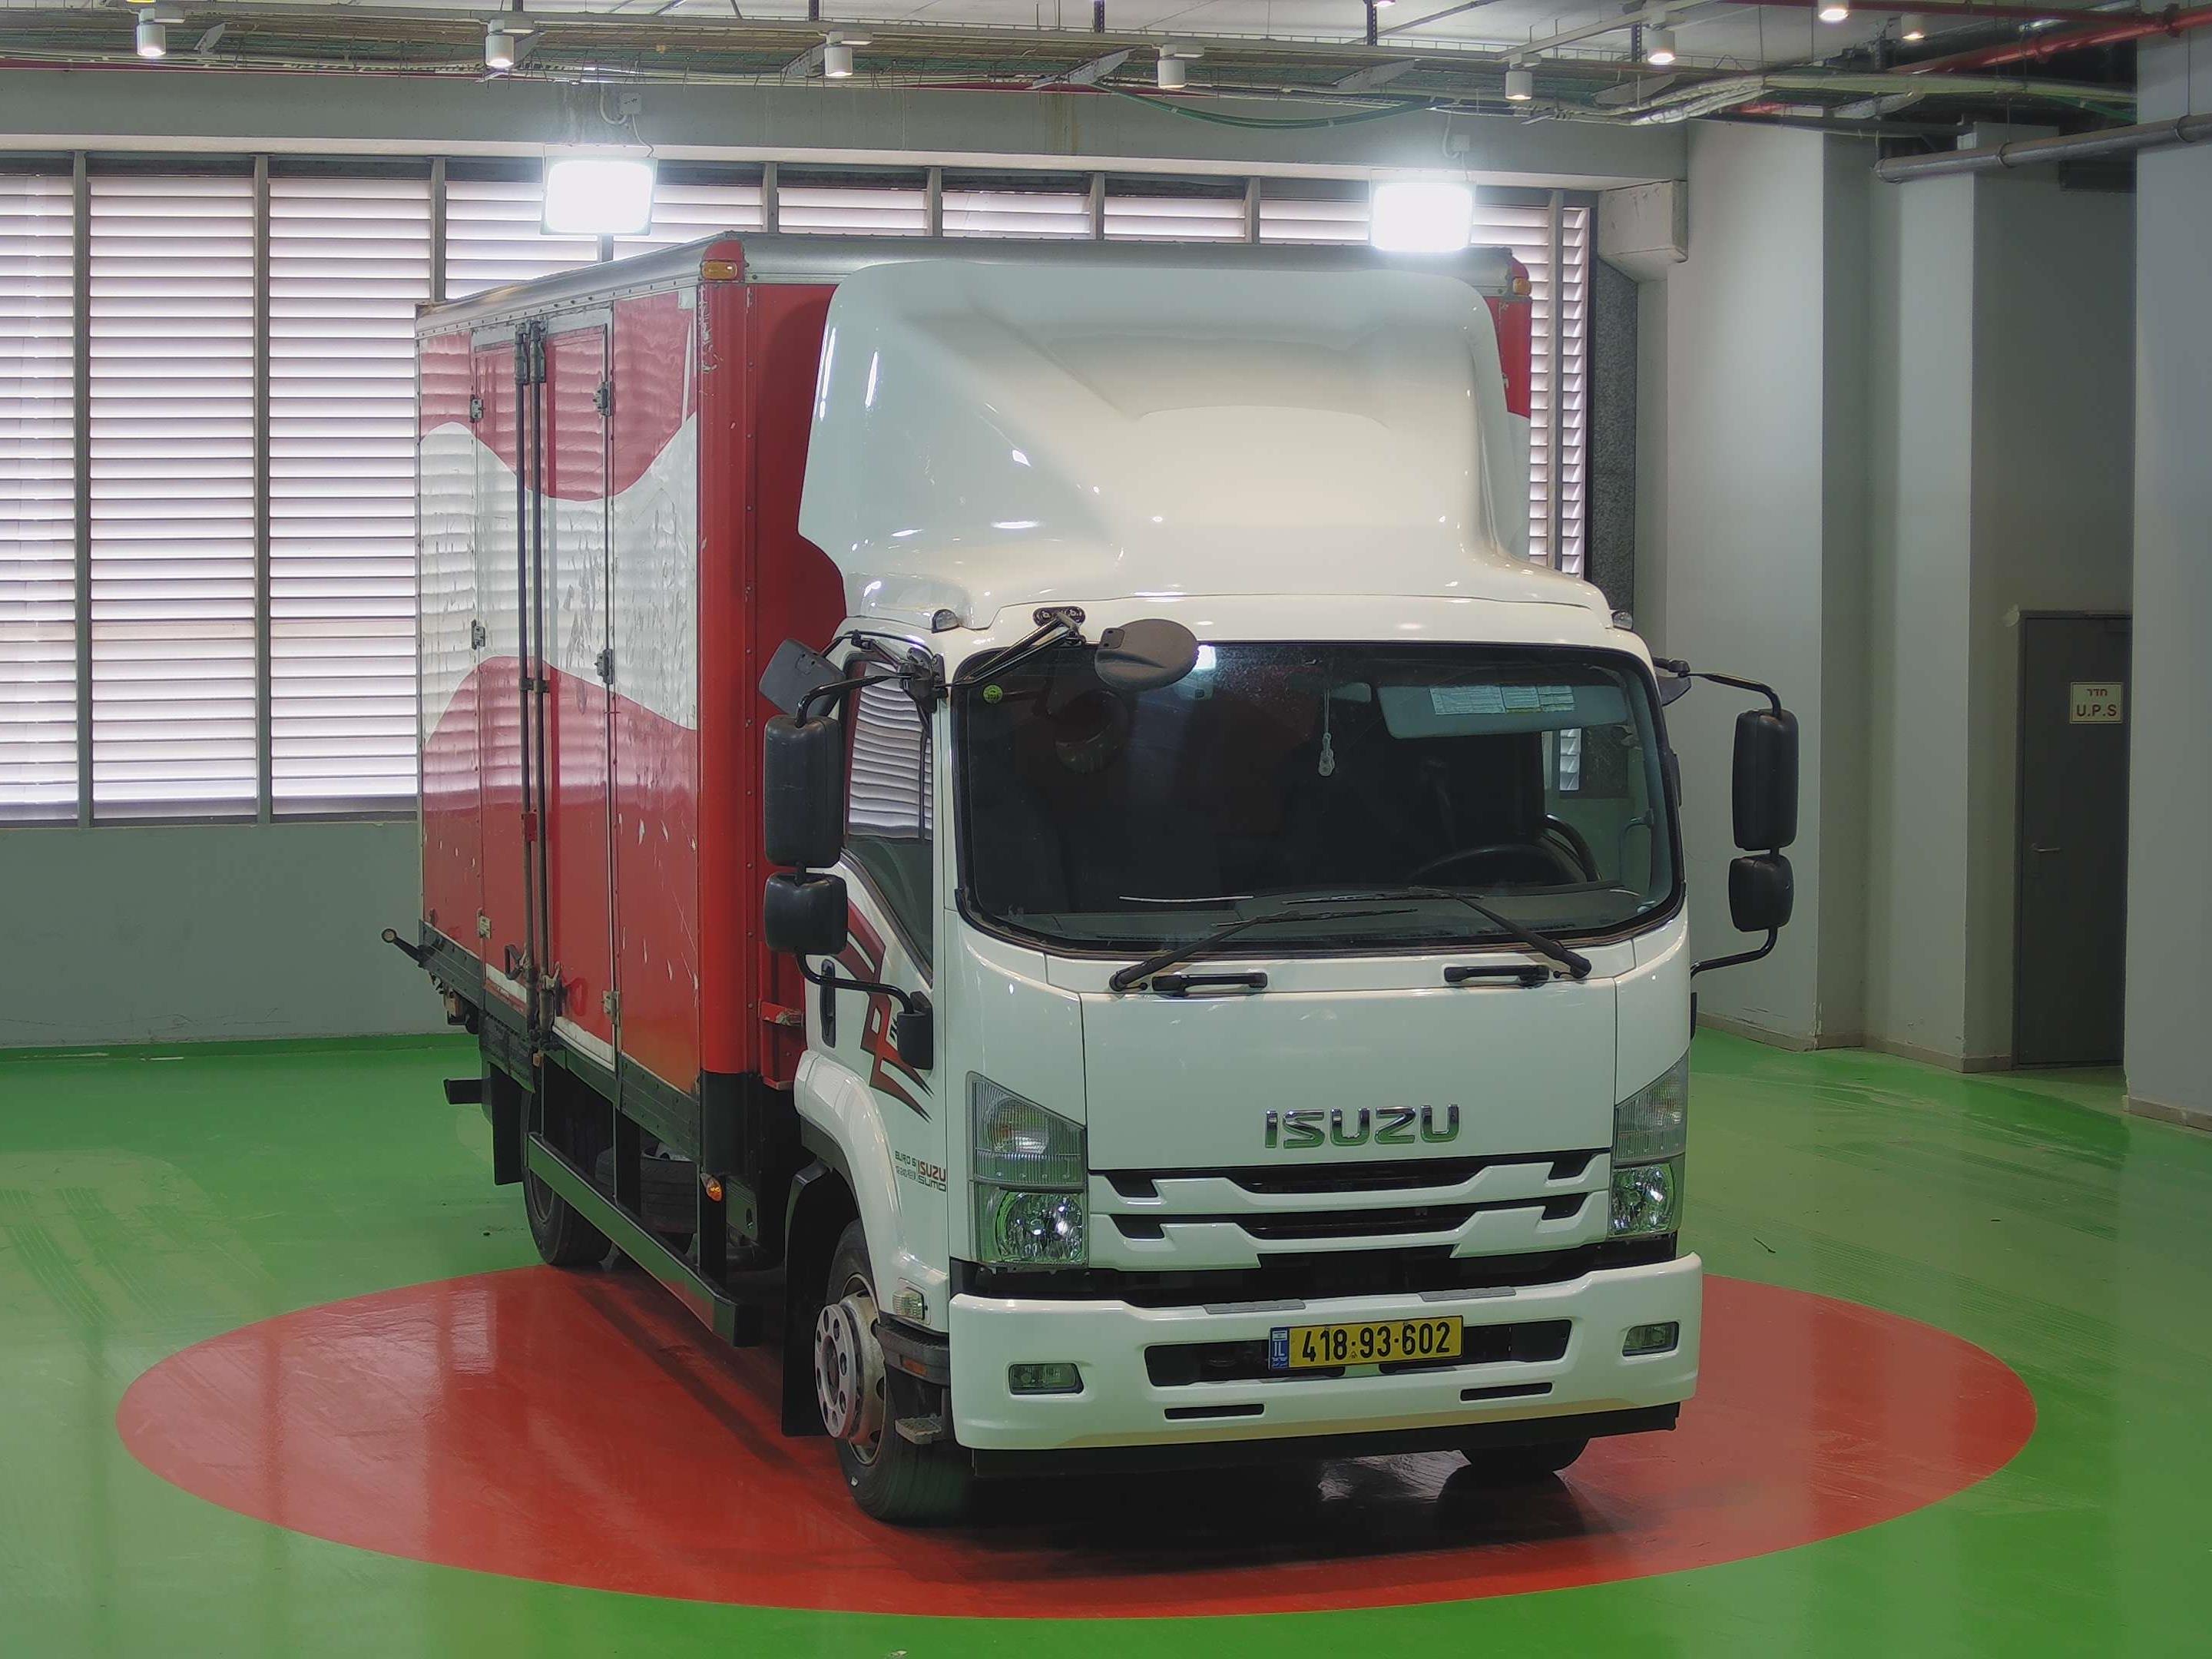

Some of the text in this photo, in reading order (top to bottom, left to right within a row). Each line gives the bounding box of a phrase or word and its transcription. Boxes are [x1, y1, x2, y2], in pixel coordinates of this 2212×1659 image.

[2077, 704, 2117, 717] U.P.S
[1265, 1104, 1459, 1149] ISUZU
[895, 1151, 911, 1165] EURO
[918, 1160, 946, 1182] ISUZU
[918, 1175, 946, 1192] SUMO
[1273, 1341, 1285, 1357] IL
